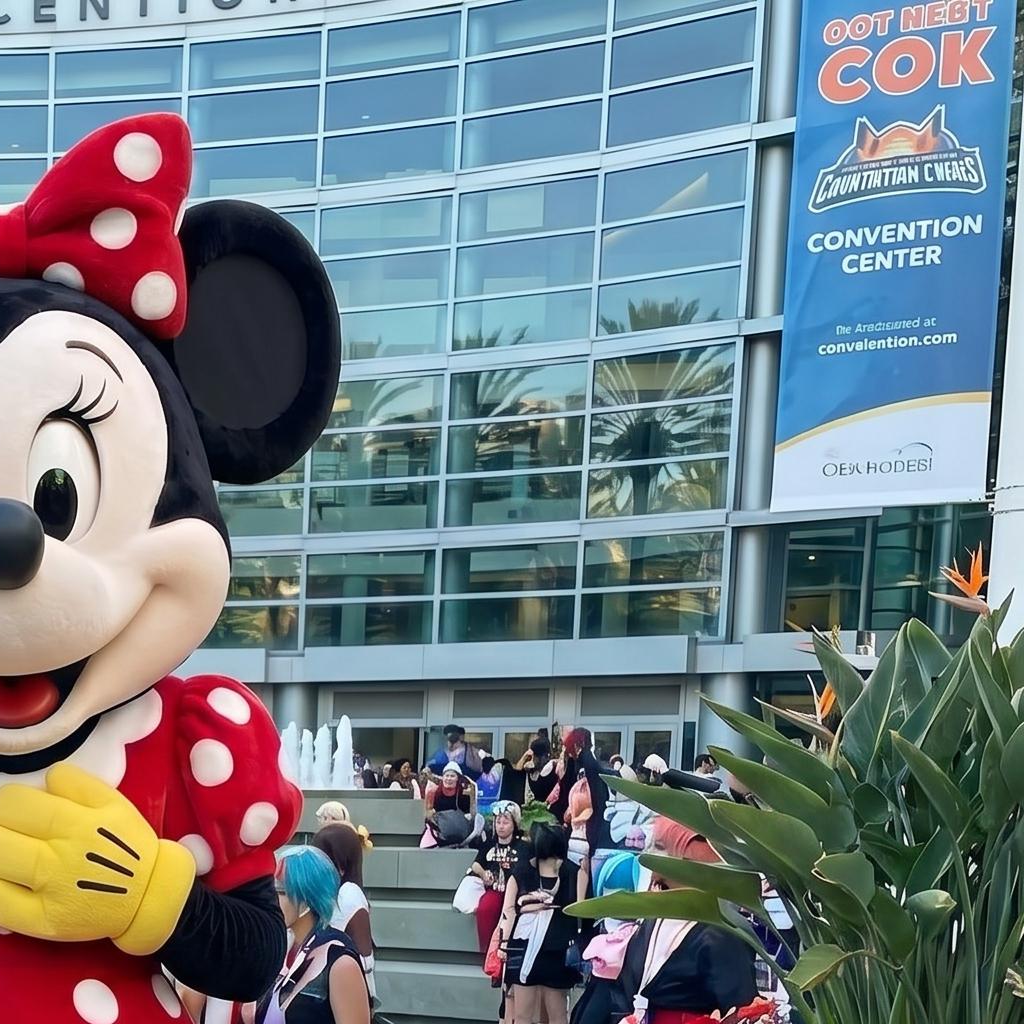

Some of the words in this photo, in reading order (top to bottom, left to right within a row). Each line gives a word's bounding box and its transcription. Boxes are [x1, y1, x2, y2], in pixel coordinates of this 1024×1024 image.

[819, 28, 996, 103] COK
[807, 214, 983, 254] CONVENTION
[841, 245, 942, 275] CENTER
[923, 317, 937, 327] at
[818, 333, 957, 355] convalention.com
